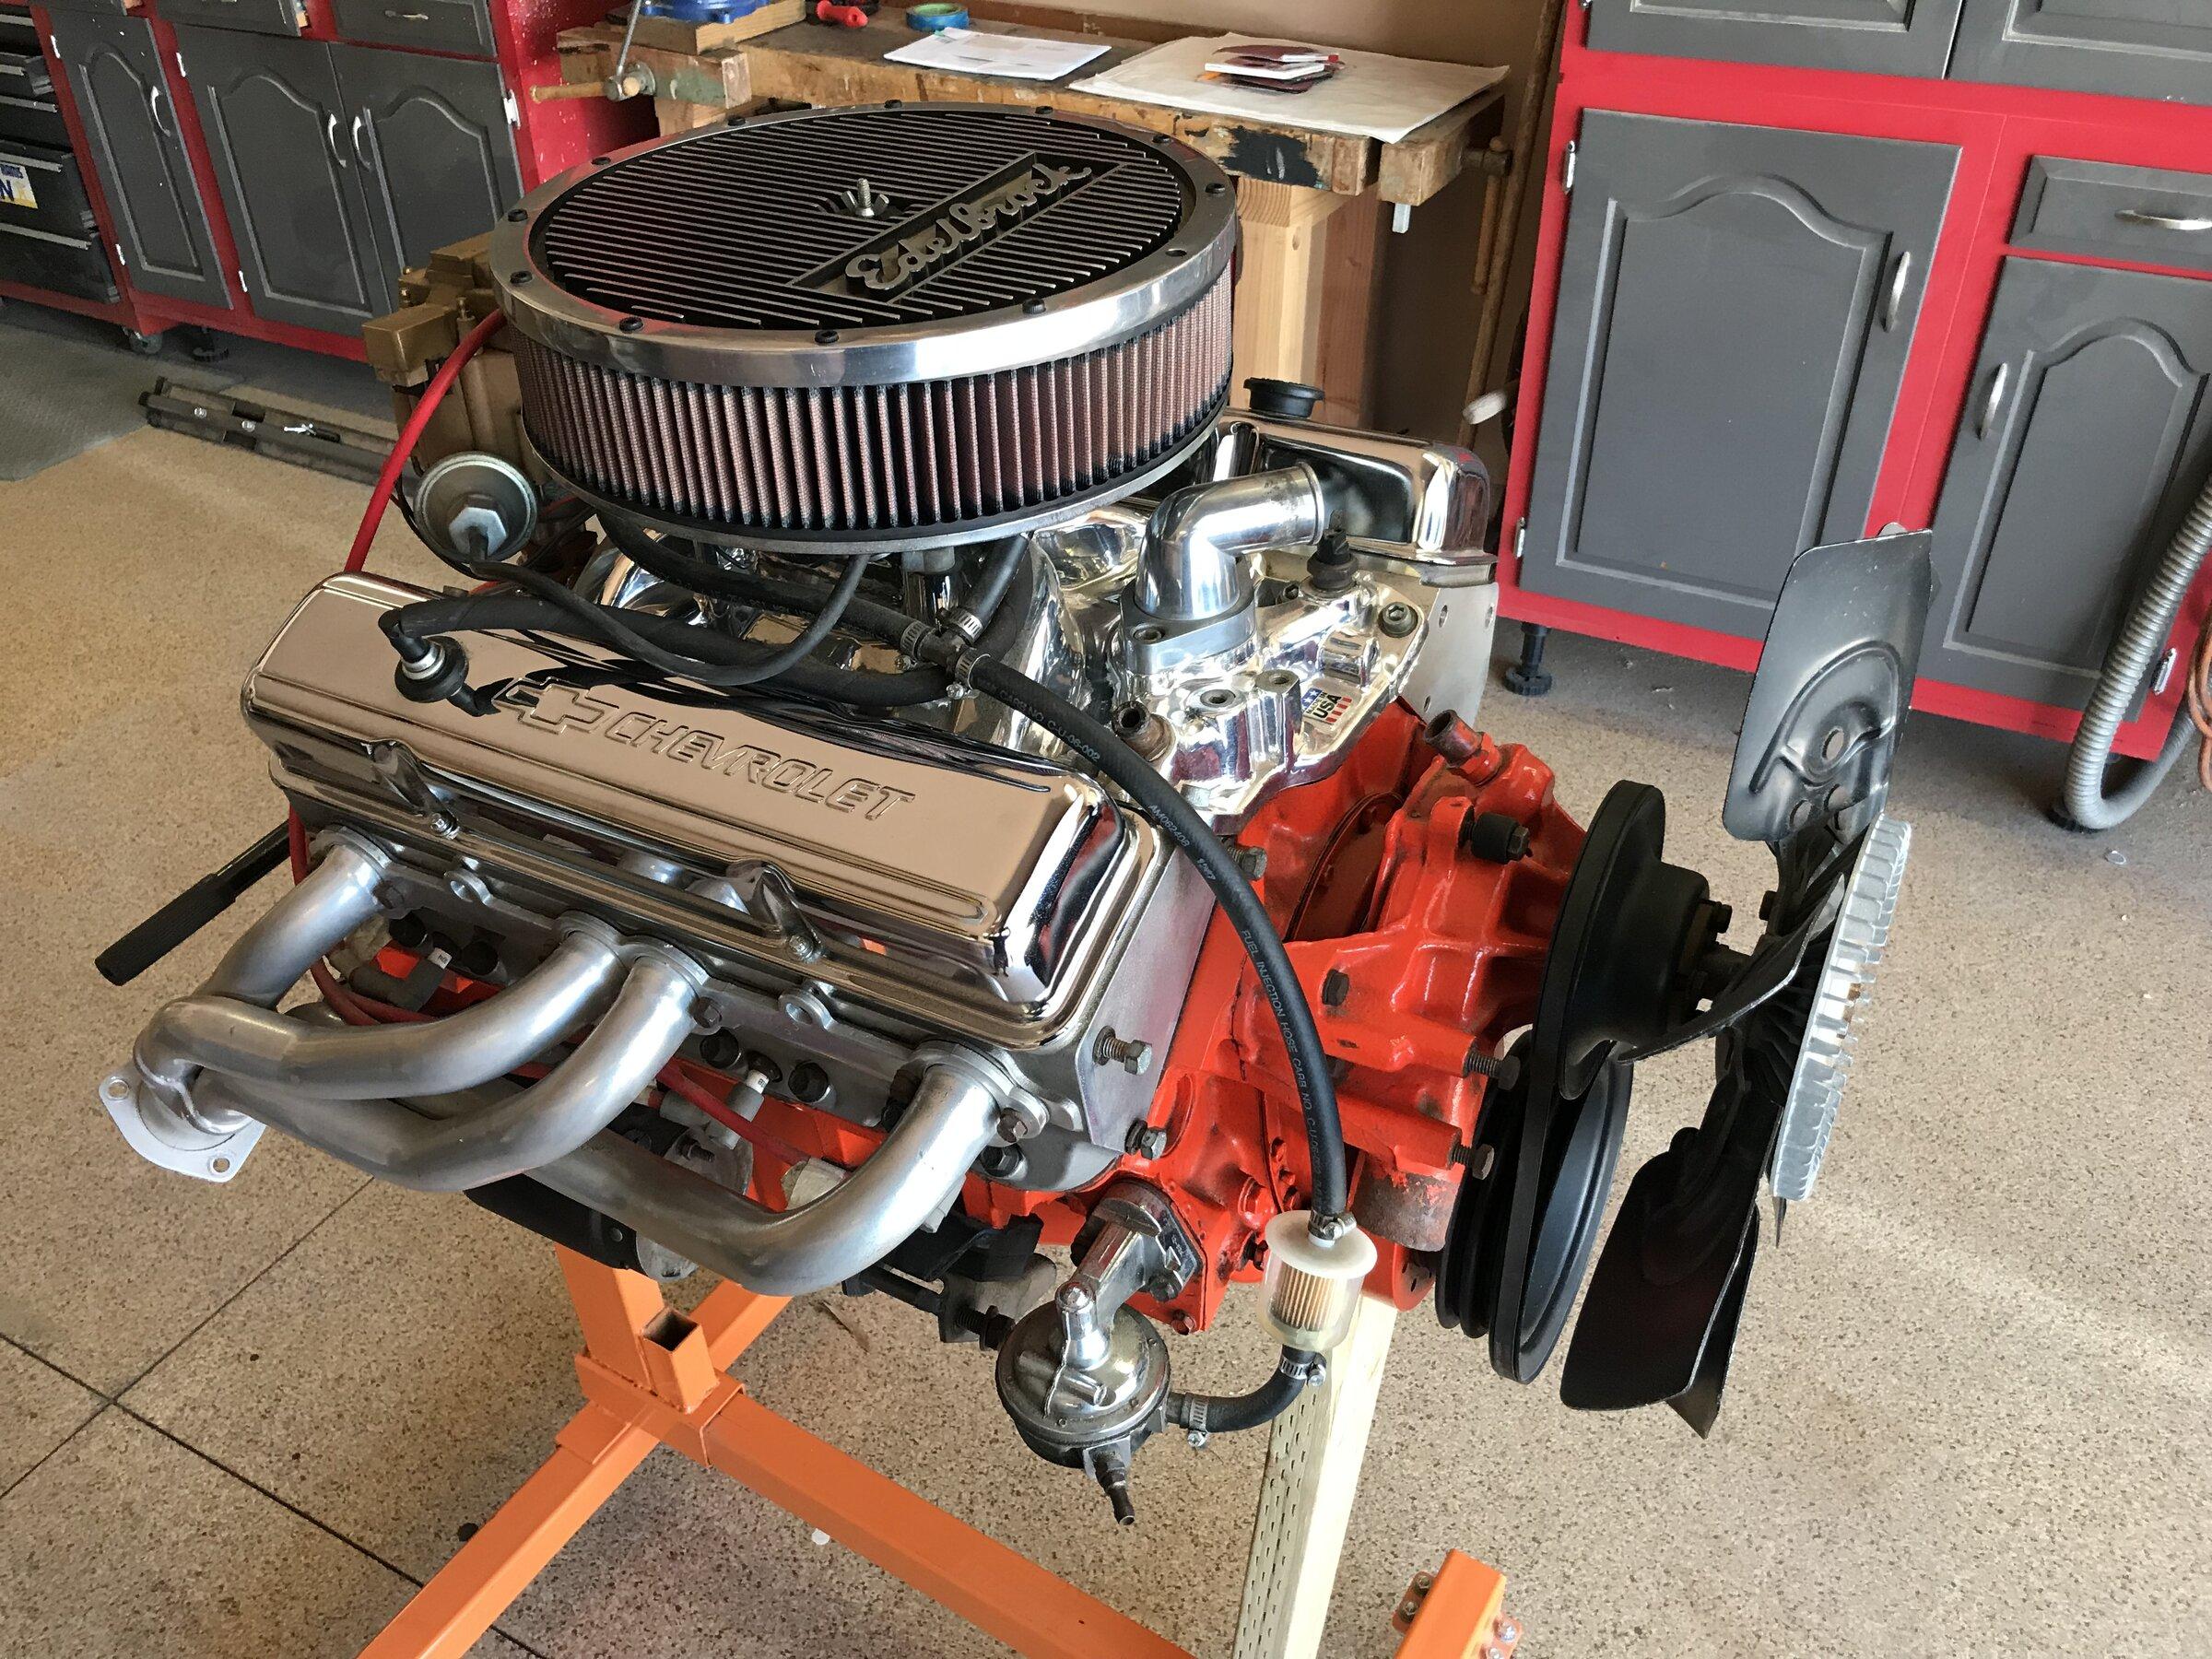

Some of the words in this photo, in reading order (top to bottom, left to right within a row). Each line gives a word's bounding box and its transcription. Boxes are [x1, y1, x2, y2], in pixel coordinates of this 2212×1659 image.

[845, 163, 1092, 290] Edelbrock
[1029, 707, 1044, 722] NO
[1312, 694, 1342, 718] USA
[605, 711, 916, 820] CHEVROLET
[1147, 805, 1190, 847] AM062408
[1241, 929, 1259, 957] FUEL
[1255, 960, 1286, 1017] INJECTION
[1280, 1021, 1299, 1053] HOSE
[1291, 1058, 1307, 1088] CARB
[1302, 1091, 1312, 1111] NO
